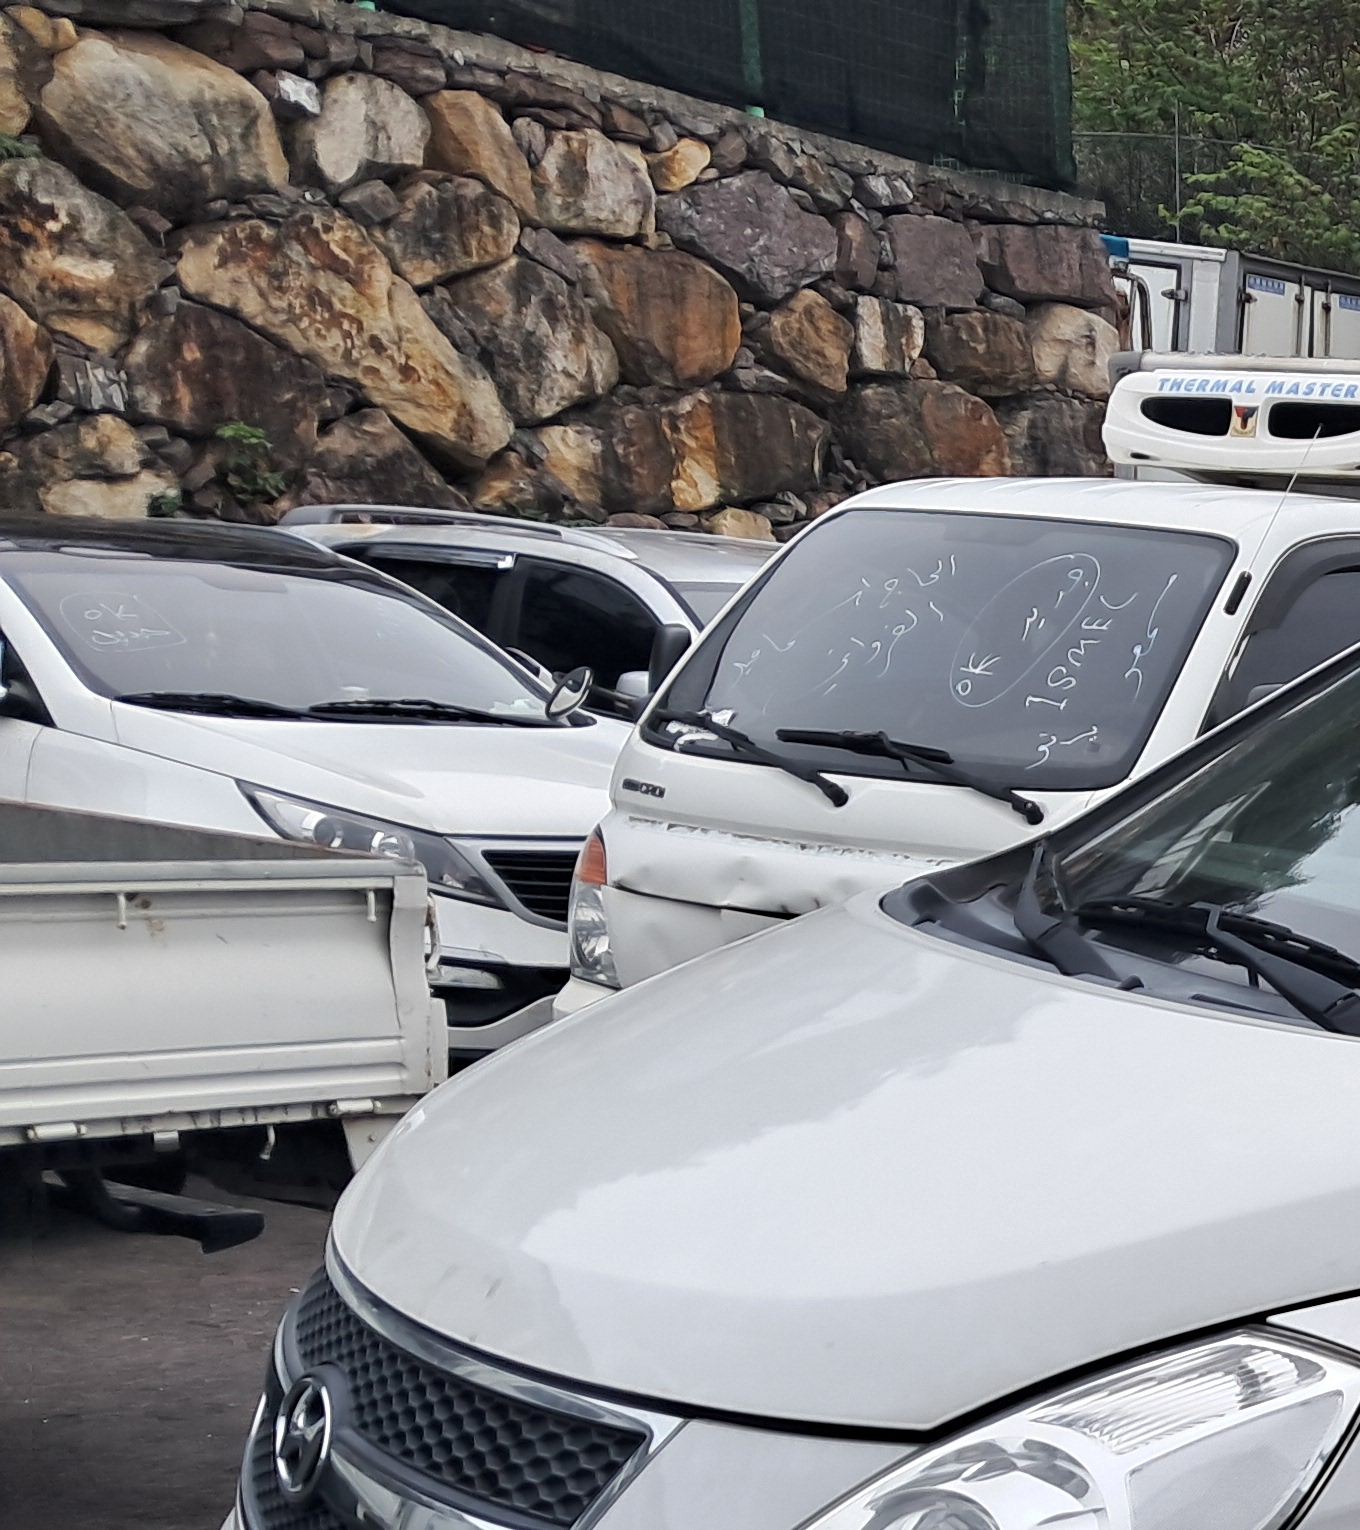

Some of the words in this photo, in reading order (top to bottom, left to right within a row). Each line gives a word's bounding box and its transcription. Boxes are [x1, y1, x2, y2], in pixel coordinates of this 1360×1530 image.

[1157, 377, 1257, 395] THERMAL
[1265, 380, 1360, 398] MASTER
[84, 603, 138, 621] OK
[955, 652, 1001, 696] OK
